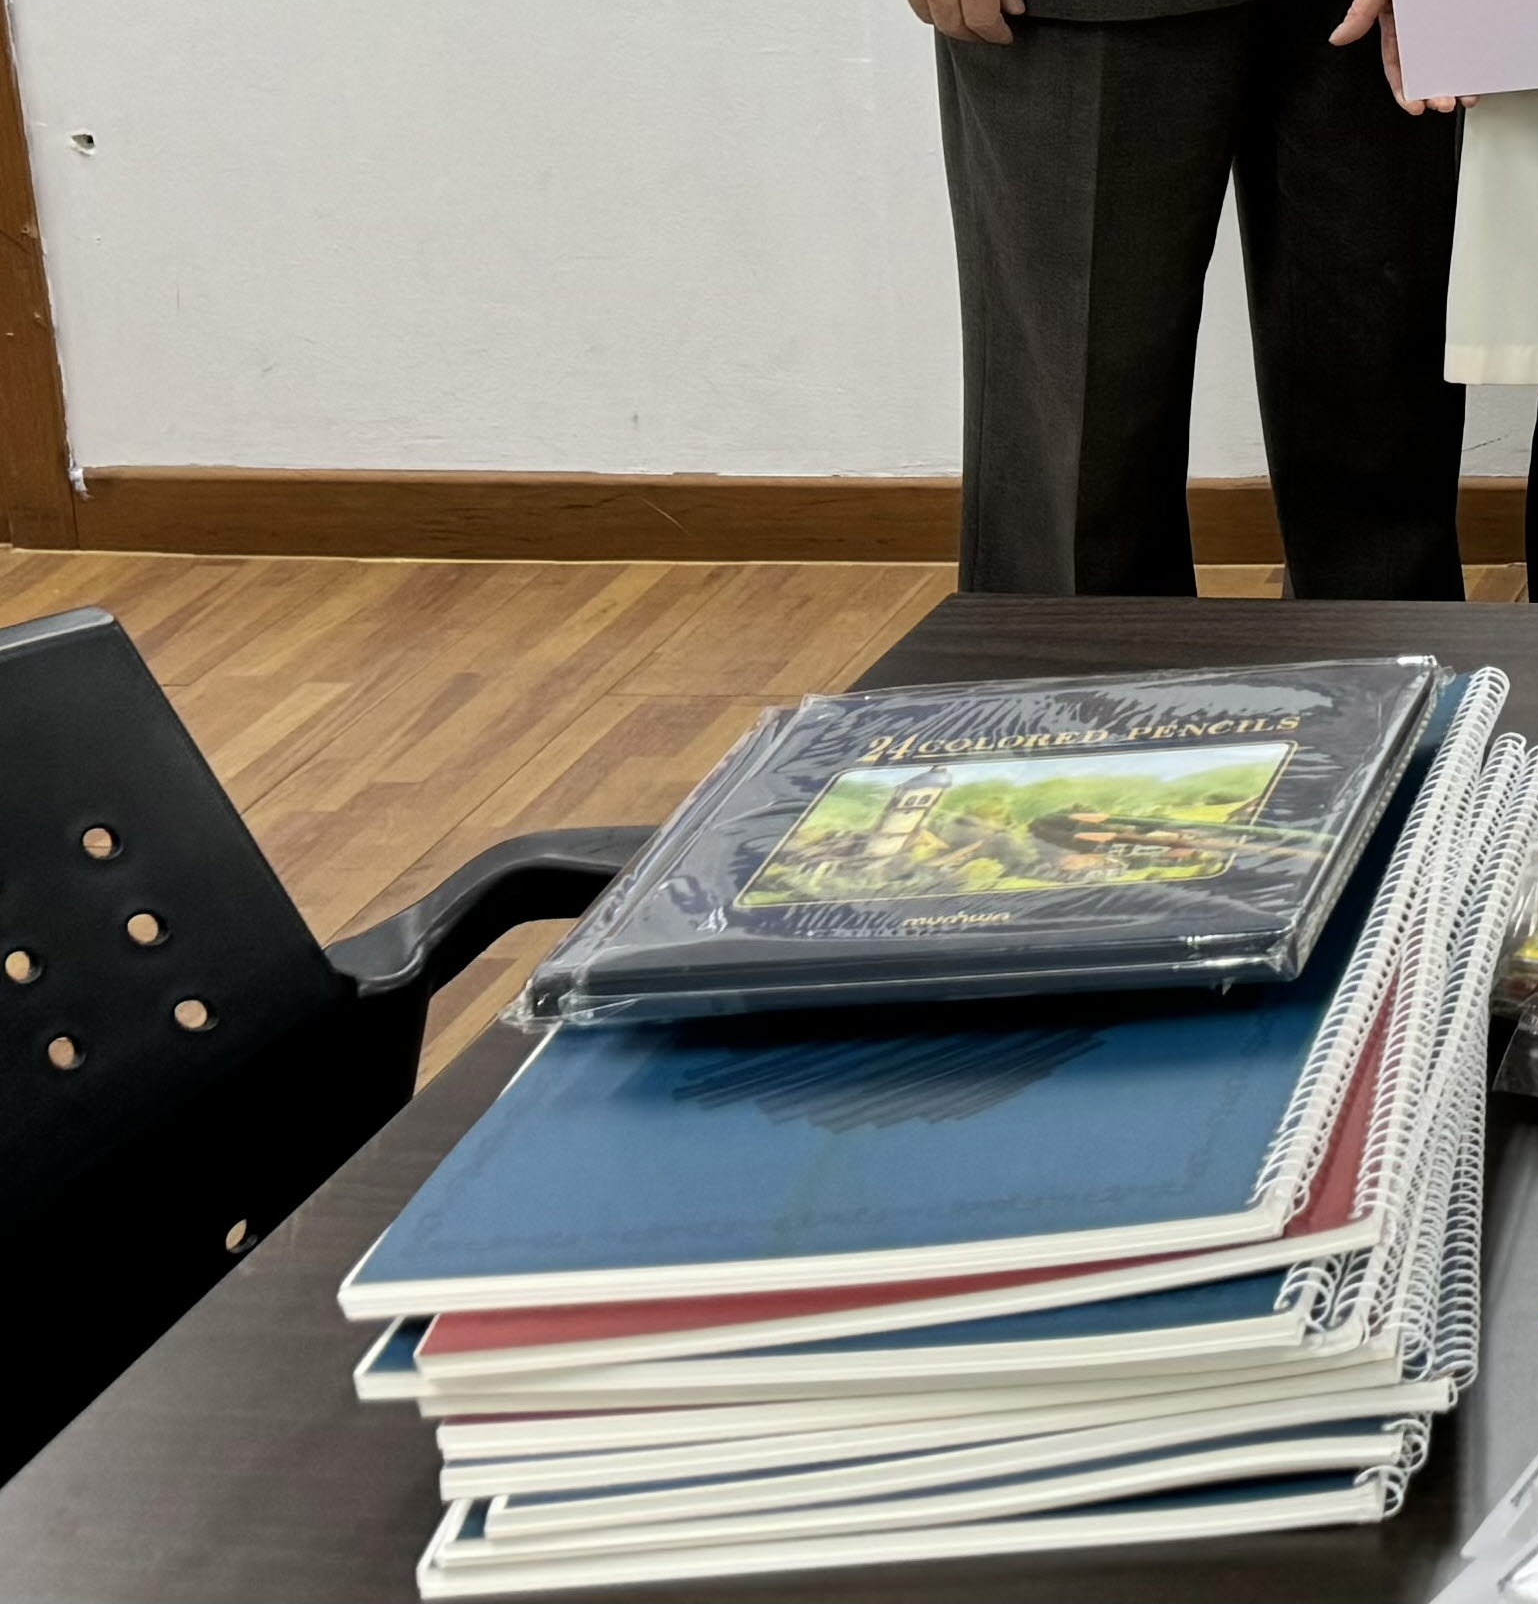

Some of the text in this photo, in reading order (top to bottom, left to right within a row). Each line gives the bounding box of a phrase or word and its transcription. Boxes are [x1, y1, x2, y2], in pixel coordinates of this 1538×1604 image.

[857, 716, 1301, 763] 24 COLORED PENCILS
